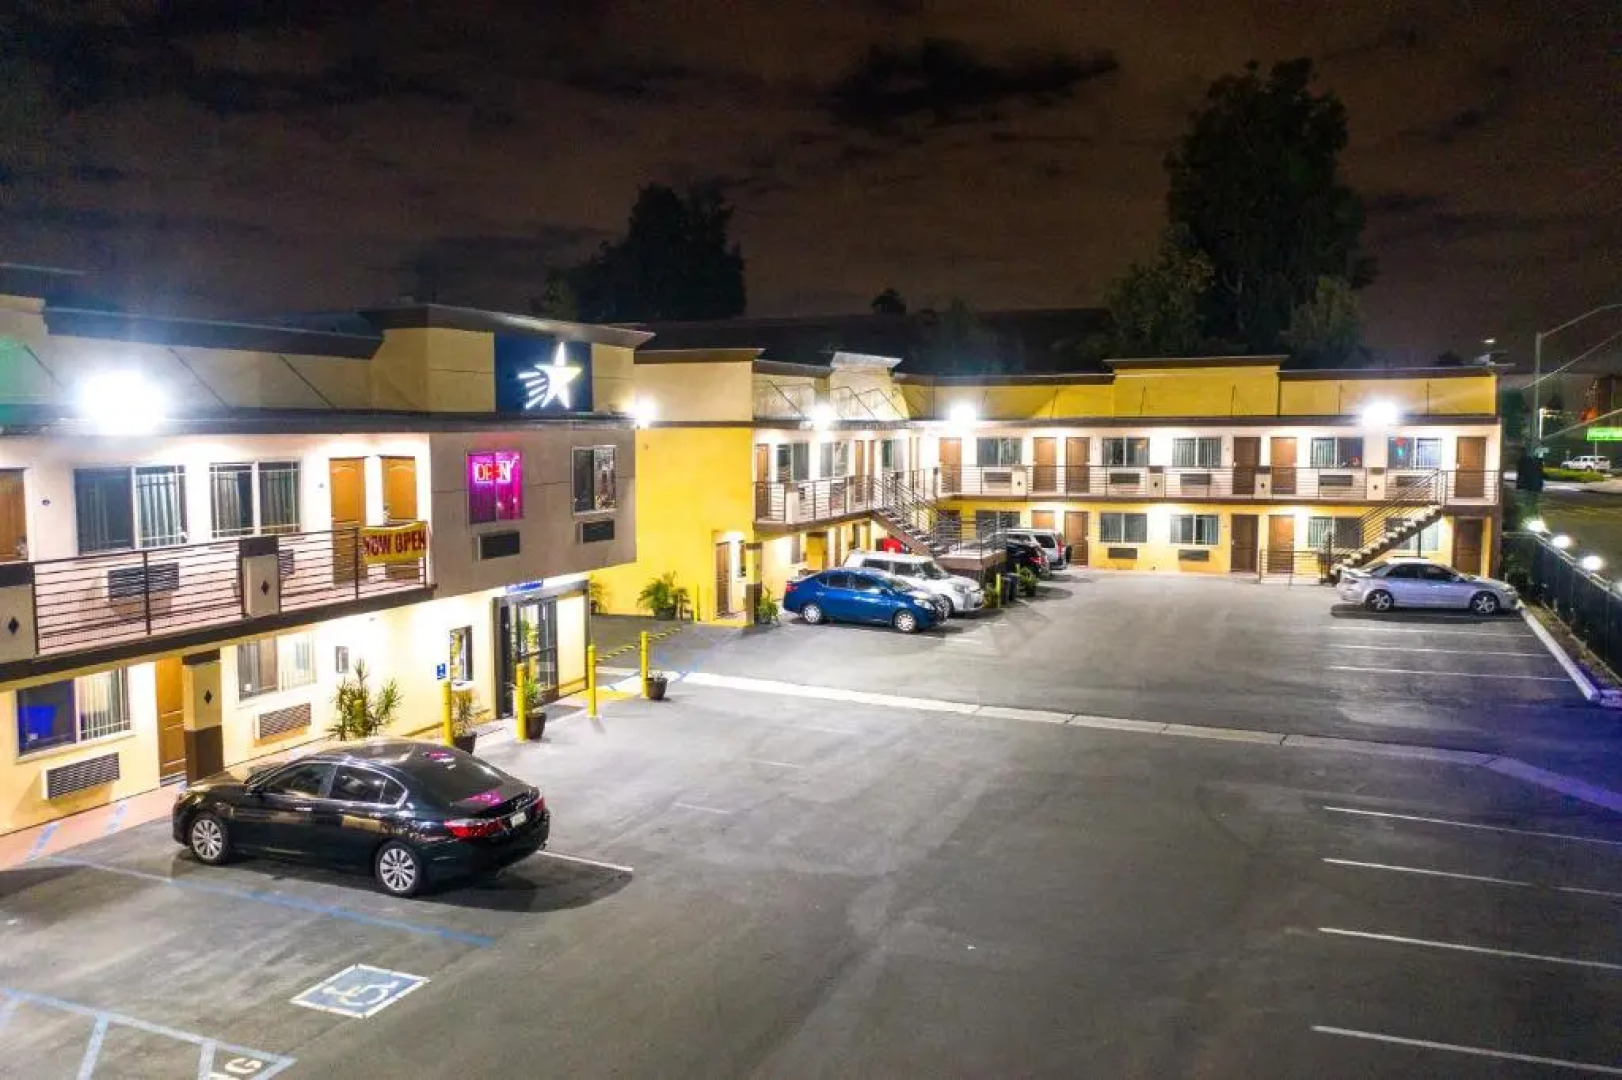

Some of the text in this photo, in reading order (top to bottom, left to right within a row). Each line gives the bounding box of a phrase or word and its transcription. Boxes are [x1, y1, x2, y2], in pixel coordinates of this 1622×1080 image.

[476, 462, 511, 482] OPEN
[363, 529, 427, 557] NOW OPEN
